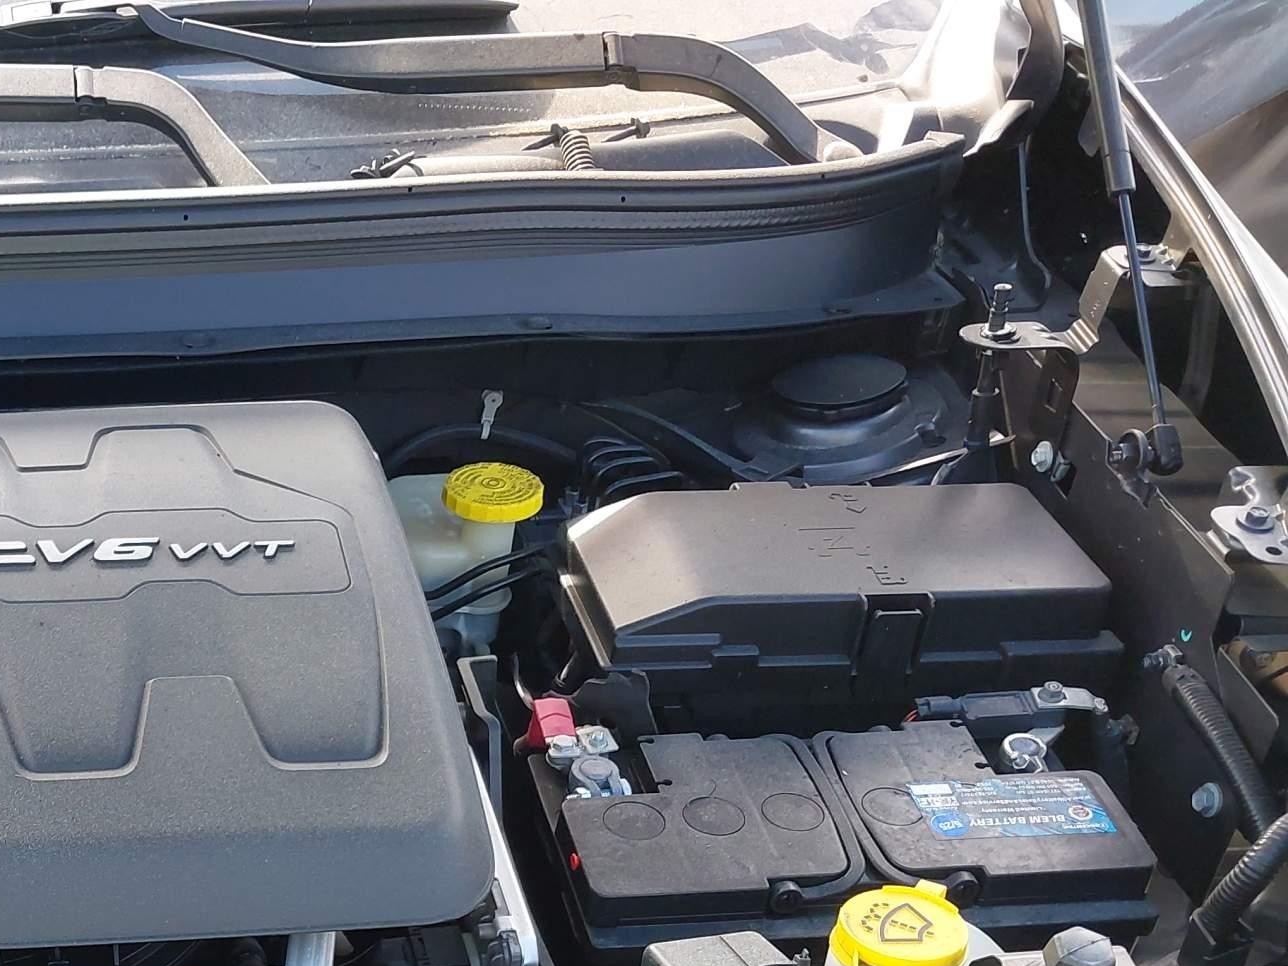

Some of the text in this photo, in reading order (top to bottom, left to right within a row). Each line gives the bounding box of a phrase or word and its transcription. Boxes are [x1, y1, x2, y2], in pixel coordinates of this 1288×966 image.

[36, 536, 295, 564] V6 VVT
[969, 814, 1065, 827] BLEM BATTERY
